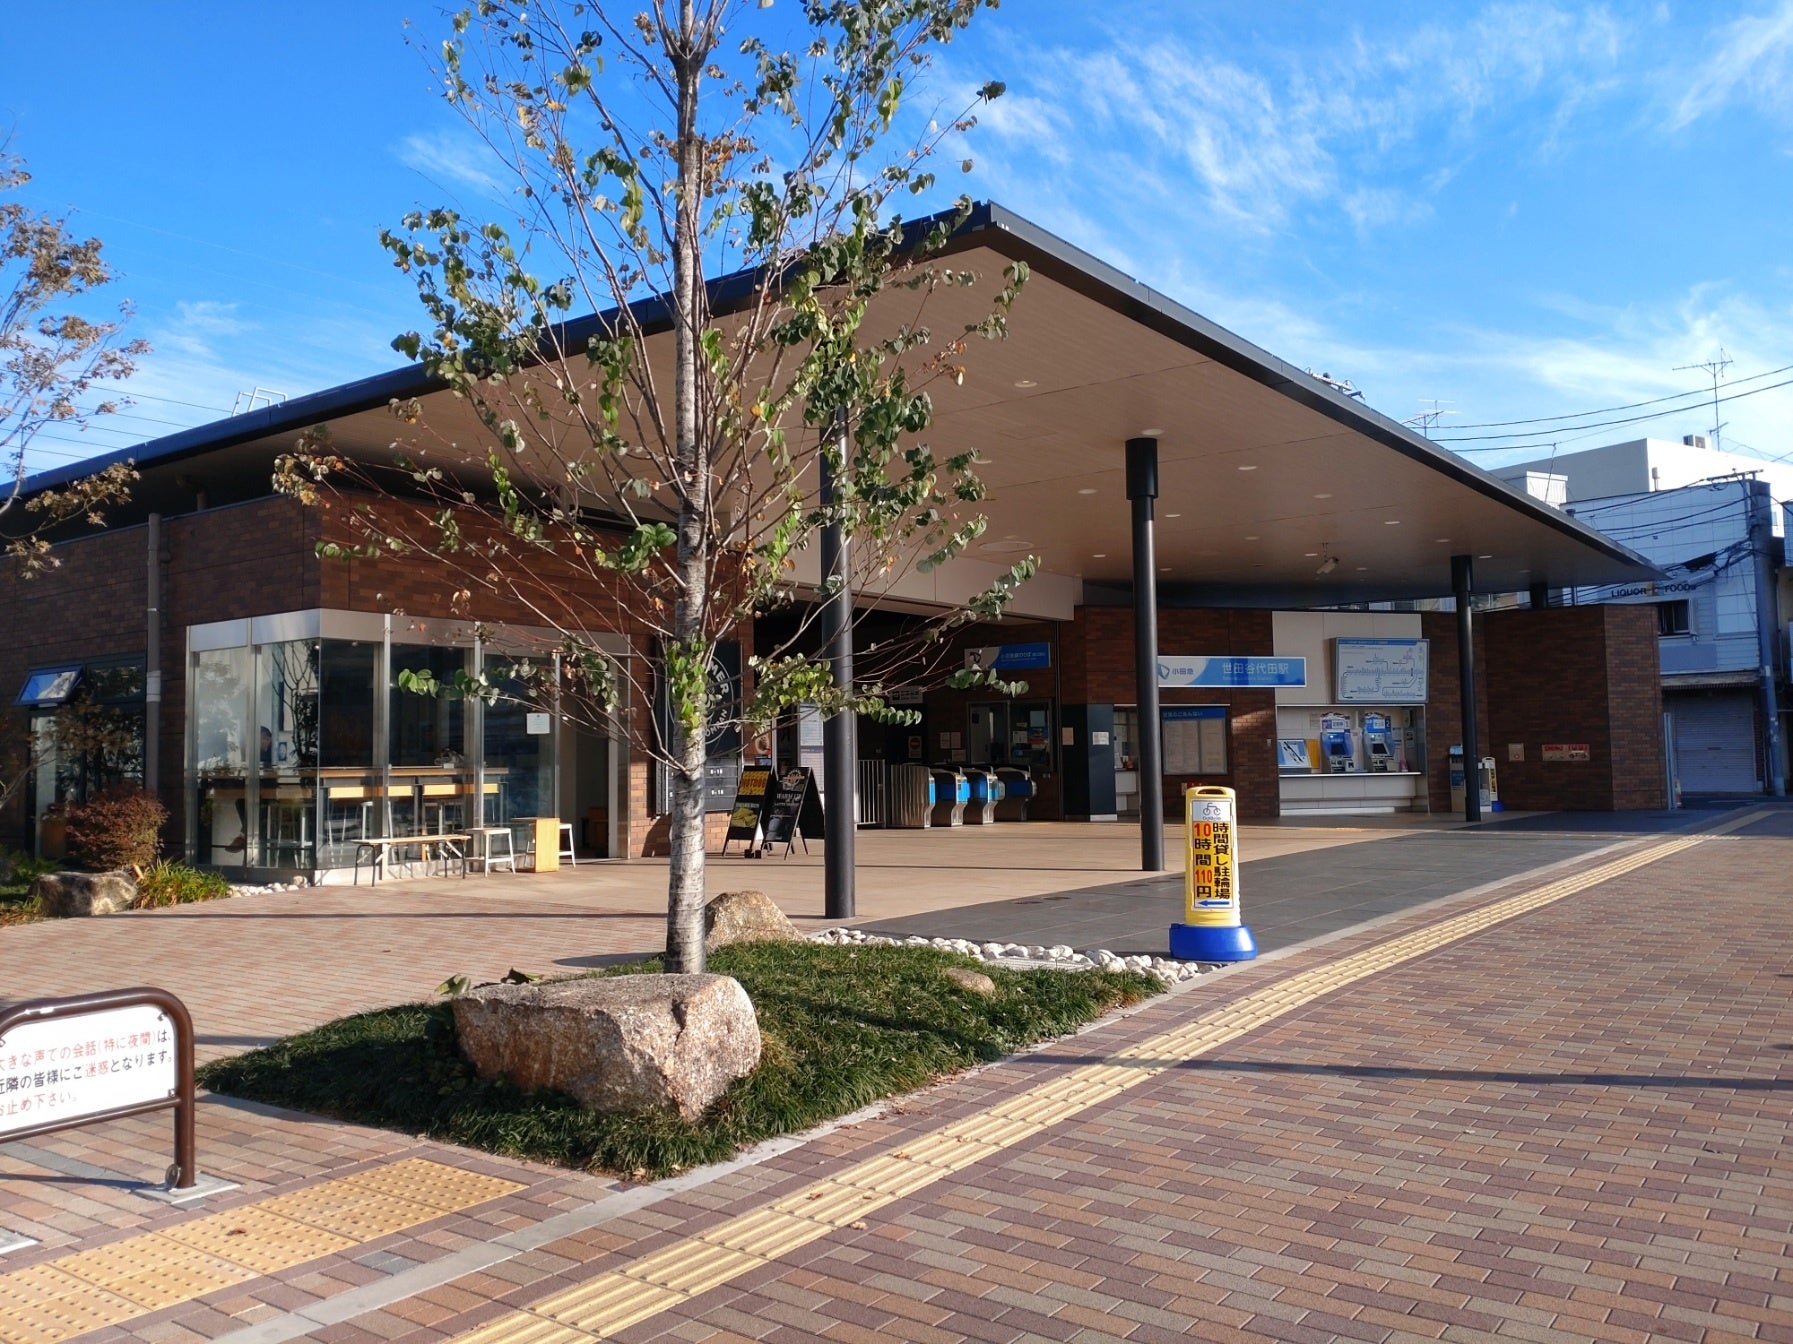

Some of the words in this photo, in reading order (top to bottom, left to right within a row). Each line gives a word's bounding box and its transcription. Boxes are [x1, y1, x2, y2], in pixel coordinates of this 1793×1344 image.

[1610, 588, 1647, 597] LIQUOR
[1171, 667, 1194, 676] 小田急
[1222, 661, 1289, 675] 世田谷代田駅
[1194, 822, 1213, 899] 10時間110円
[1212, 822, 1231, 900] 時間貸し駐輪場
